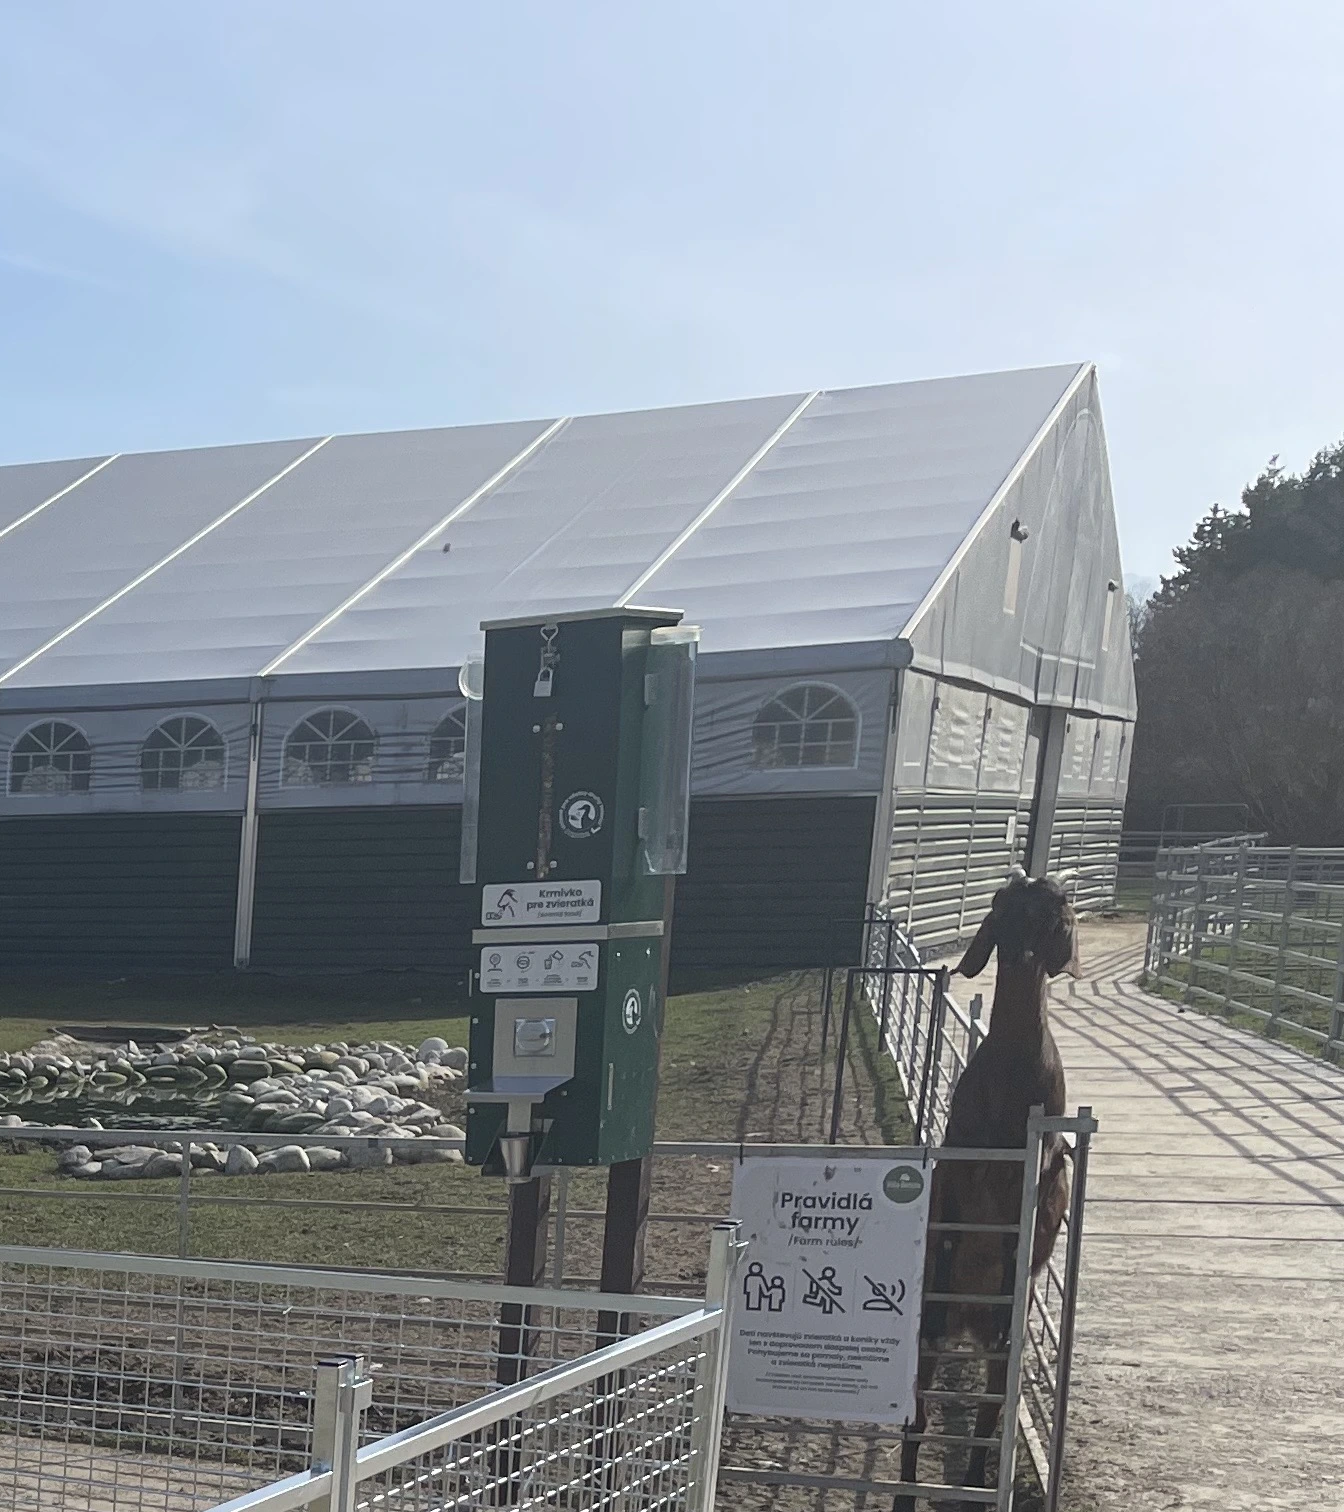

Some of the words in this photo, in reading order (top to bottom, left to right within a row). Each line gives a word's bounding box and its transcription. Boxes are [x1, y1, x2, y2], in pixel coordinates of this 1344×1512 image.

[538, 887, 583, 898] Krmivko
[526, 901, 544, 912] pre
[545, 898, 595, 909] zvieratká
[780, 1191, 873, 1210] Pravidlá
[791, 1211, 860, 1236] farmy
[787, 1234, 823, 1247] /Farm
